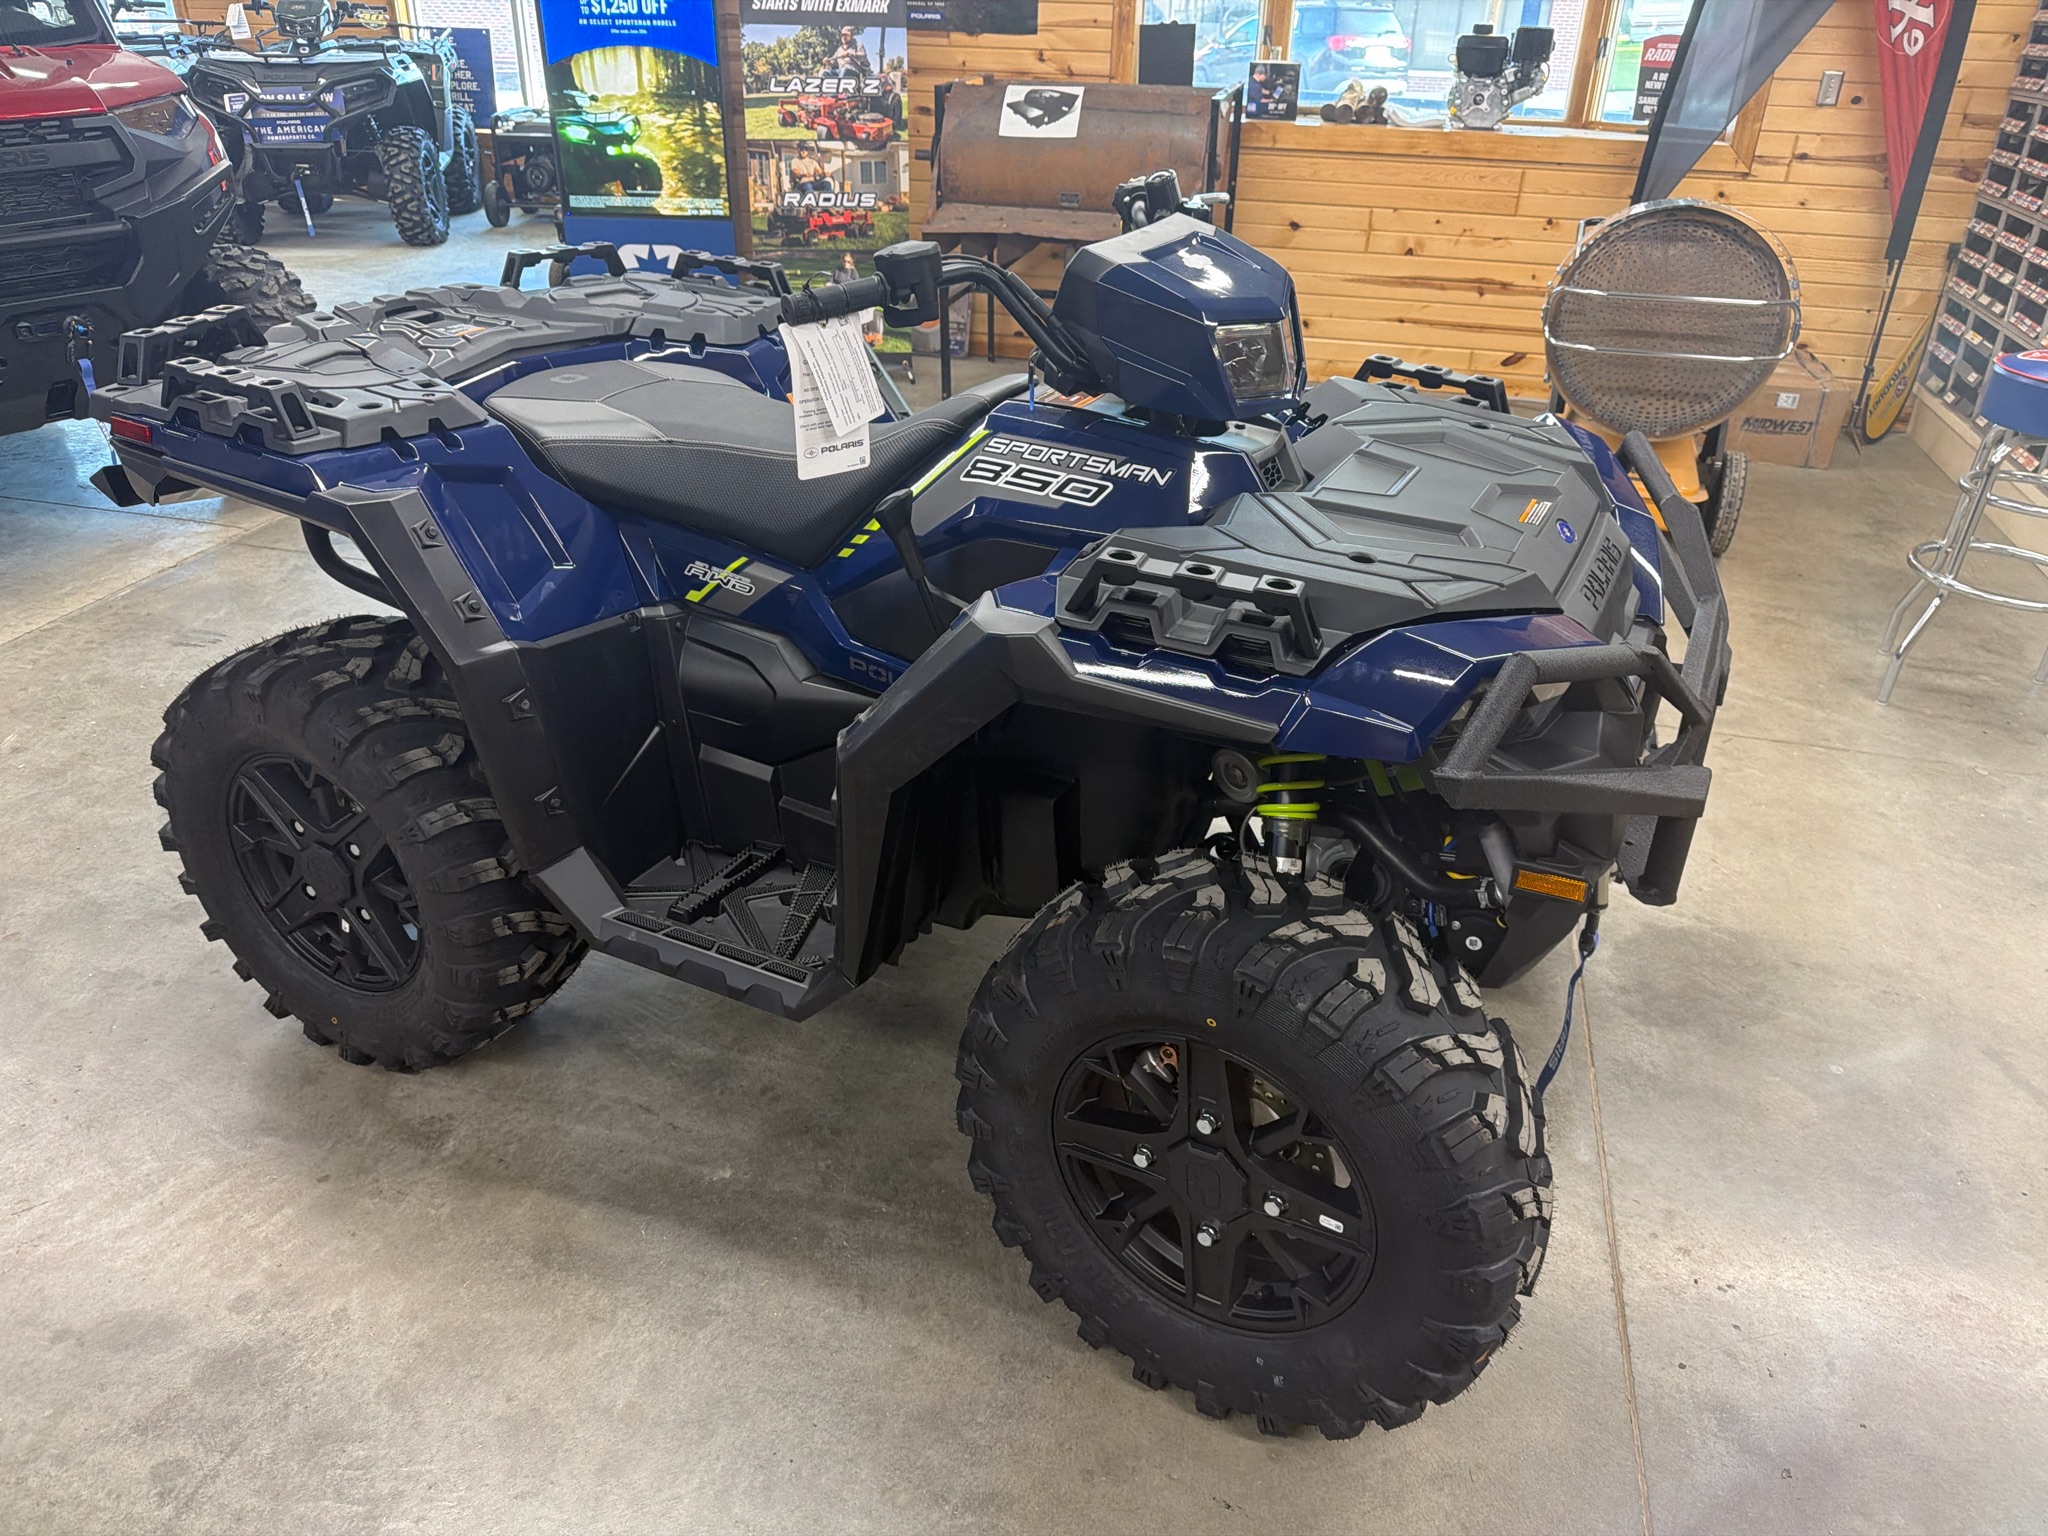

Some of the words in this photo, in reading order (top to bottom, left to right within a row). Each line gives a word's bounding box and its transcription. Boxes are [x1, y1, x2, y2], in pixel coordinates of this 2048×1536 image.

[591, 0, 638, 15] $1,250
[641, 0, 668, 14] OFF
[751, 0, 798, 10] STARTS
[801, 0, 835, 12] WITH
[836, 0, 889, 14] EXMARK
[615, 18, 651, 26] SPORTSMAN
[910, 12, 941, 20] POLARIS
[769, 77, 856, 94] LAZER
[862, 77, 882, 94] Z
[277, 124, 327, 135] AMERICAN
[782, 192, 877, 208] RADIUS
[1742, 416, 1814, 433] MIDWEST
[820, 438, 865, 455] POLARIS
[983, 436, 1174, 488] SPORTSMAN
[960, 455, 1114, 507] 850
[684, 562, 756, 597] AWD
[1579, 536, 1622, 612] POLARIS
